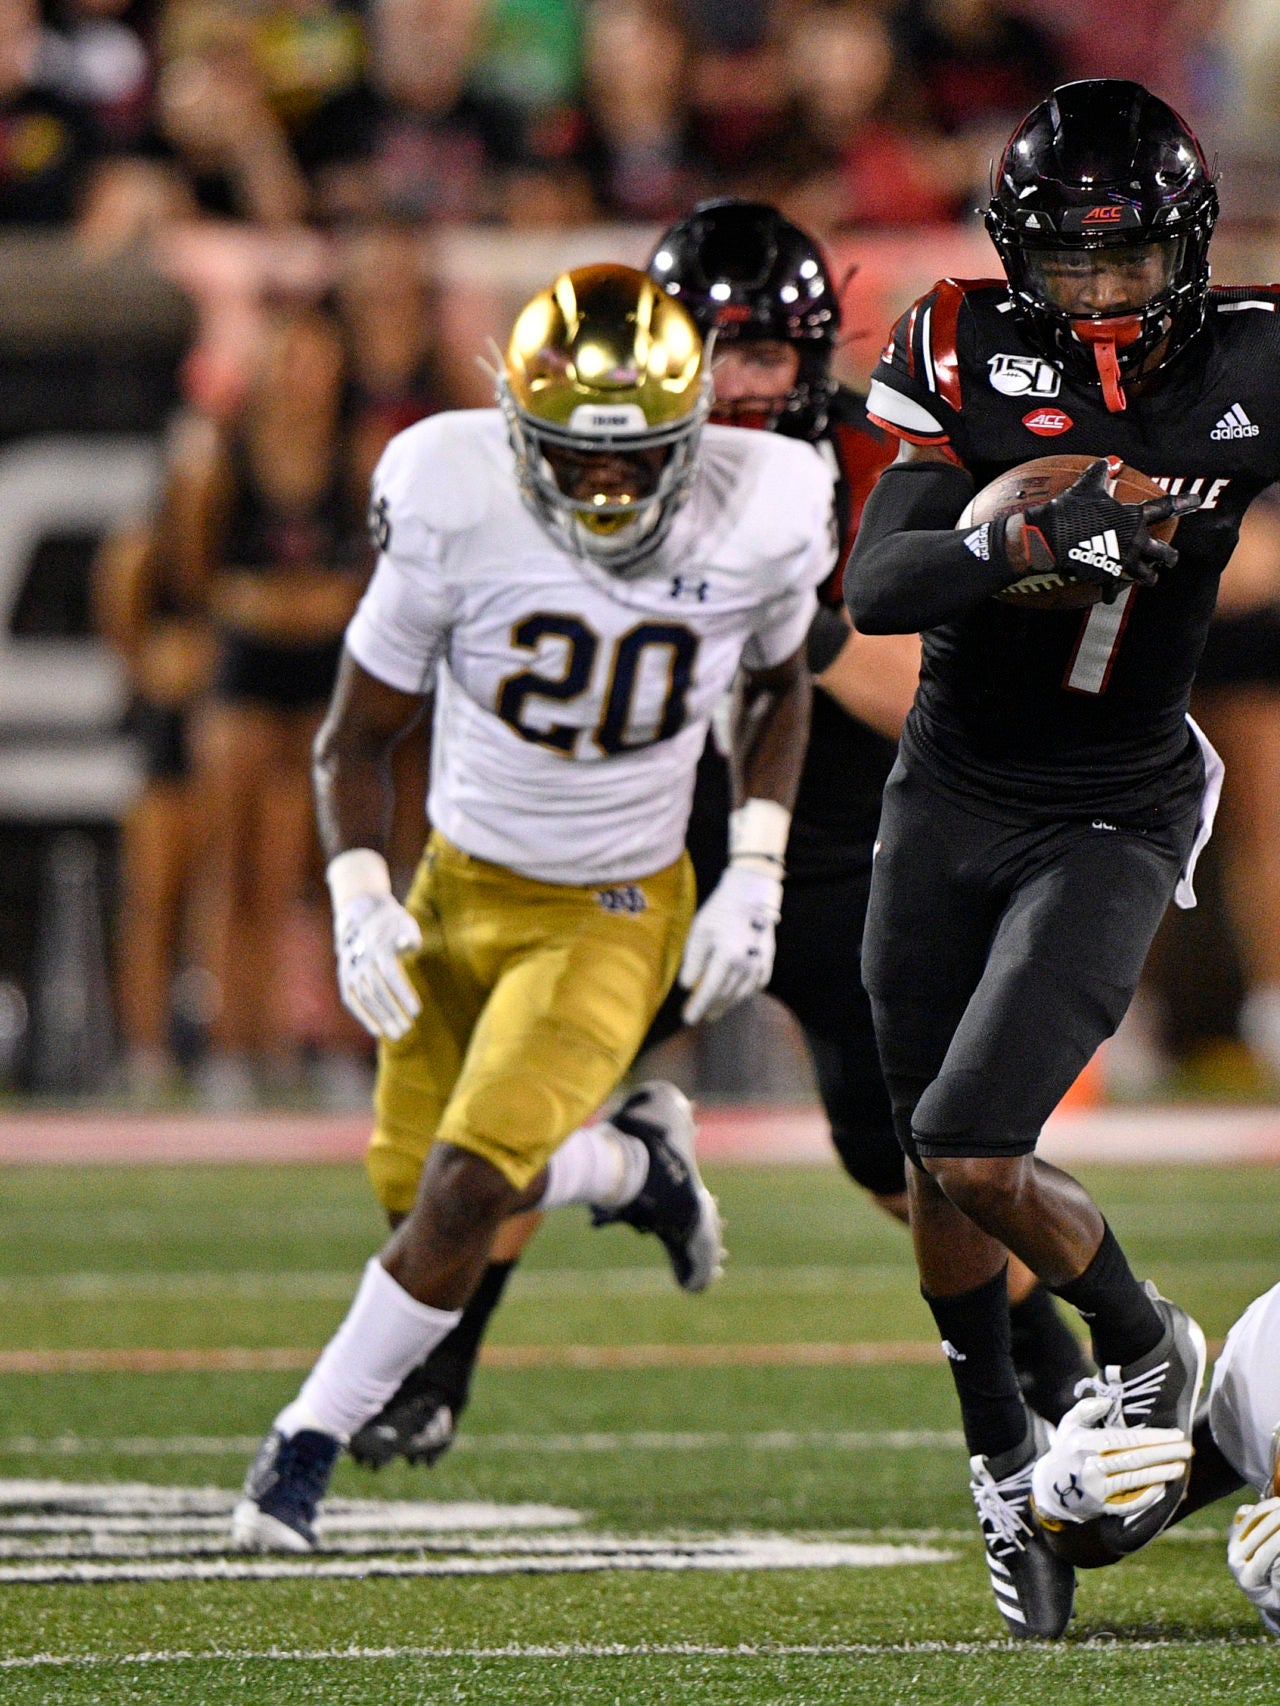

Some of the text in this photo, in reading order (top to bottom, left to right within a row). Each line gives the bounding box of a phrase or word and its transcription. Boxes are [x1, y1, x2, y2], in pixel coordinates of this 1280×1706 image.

[1084, 205, 1123, 219] ACC
[987, 353, 1061, 398] 150
[1028, 414, 1067, 426] ACC
[1210, 424, 1260, 440] adidas
[1068, 548, 1123, 577] adidas
[496, 611, 701, 761] 20
